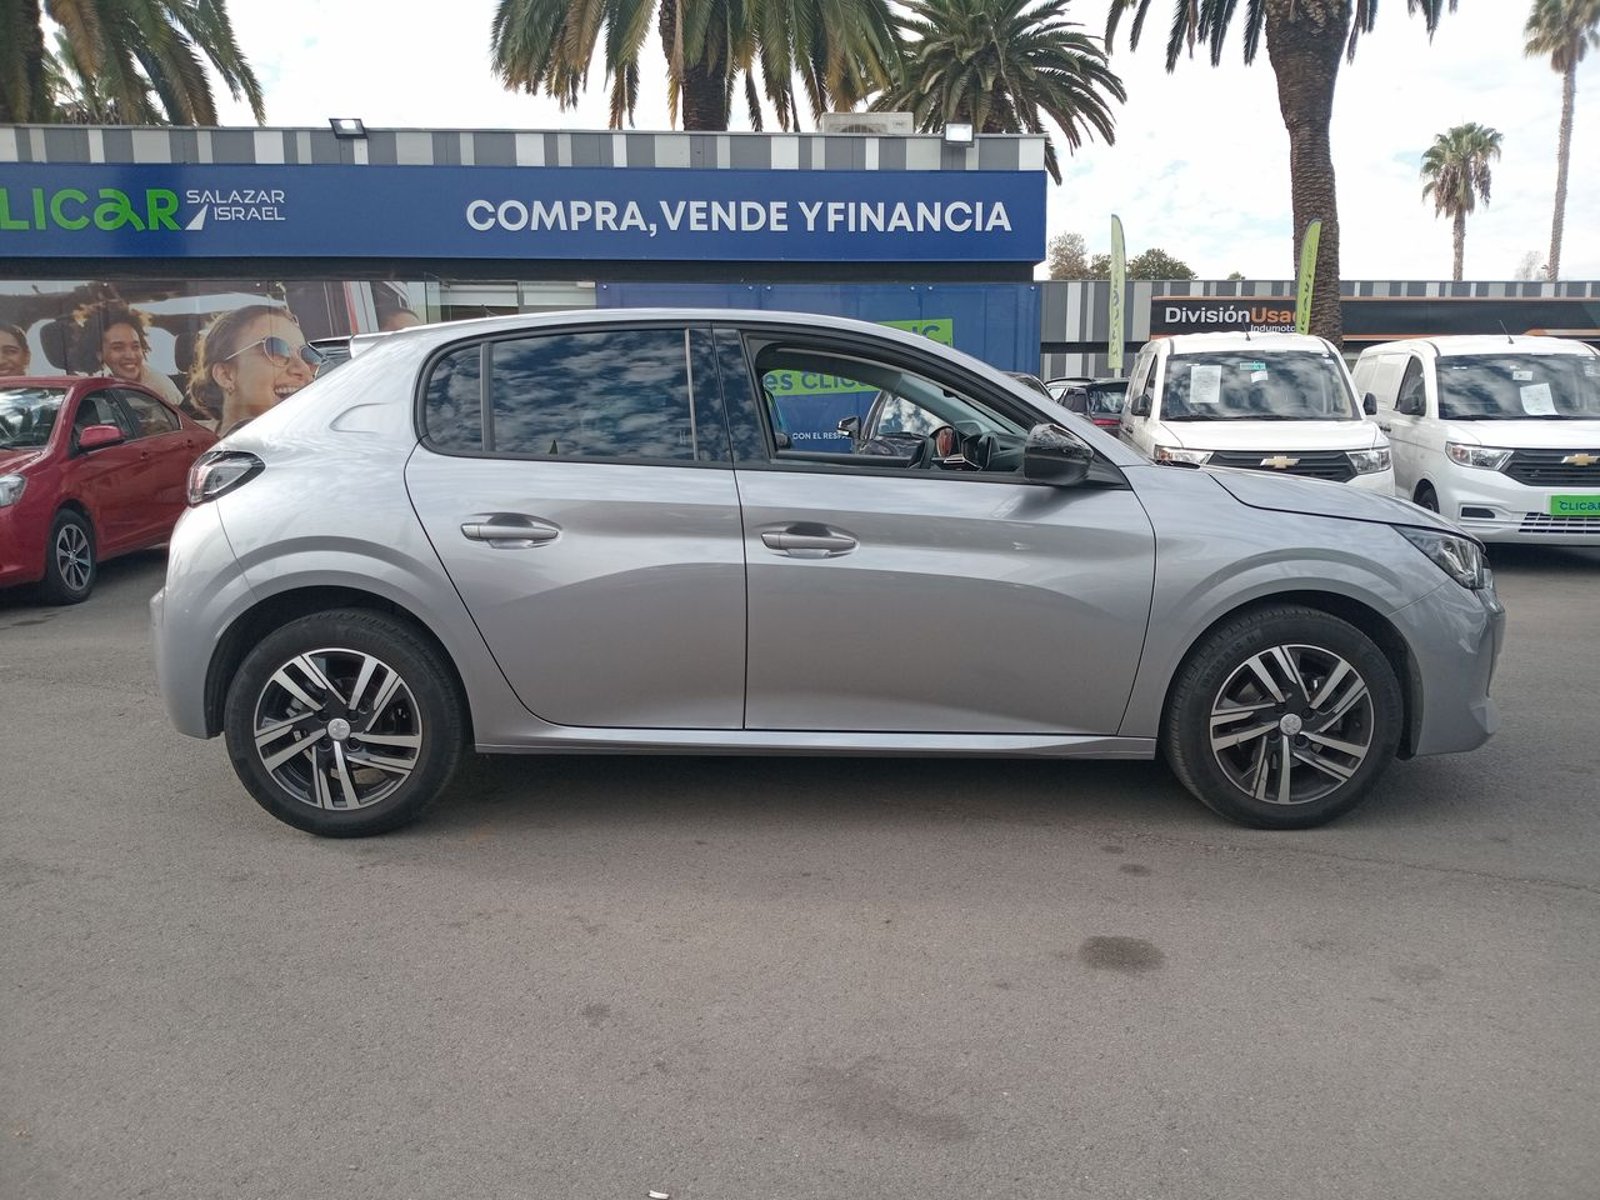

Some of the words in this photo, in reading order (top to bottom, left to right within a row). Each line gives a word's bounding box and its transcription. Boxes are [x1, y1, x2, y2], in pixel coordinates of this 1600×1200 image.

[186, 189, 286, 204] SALAZAR
[214, 207, 286, 221] ISRAEL
[792, 432, 811, 440] CON
[813, 432, 822, 440] EL
